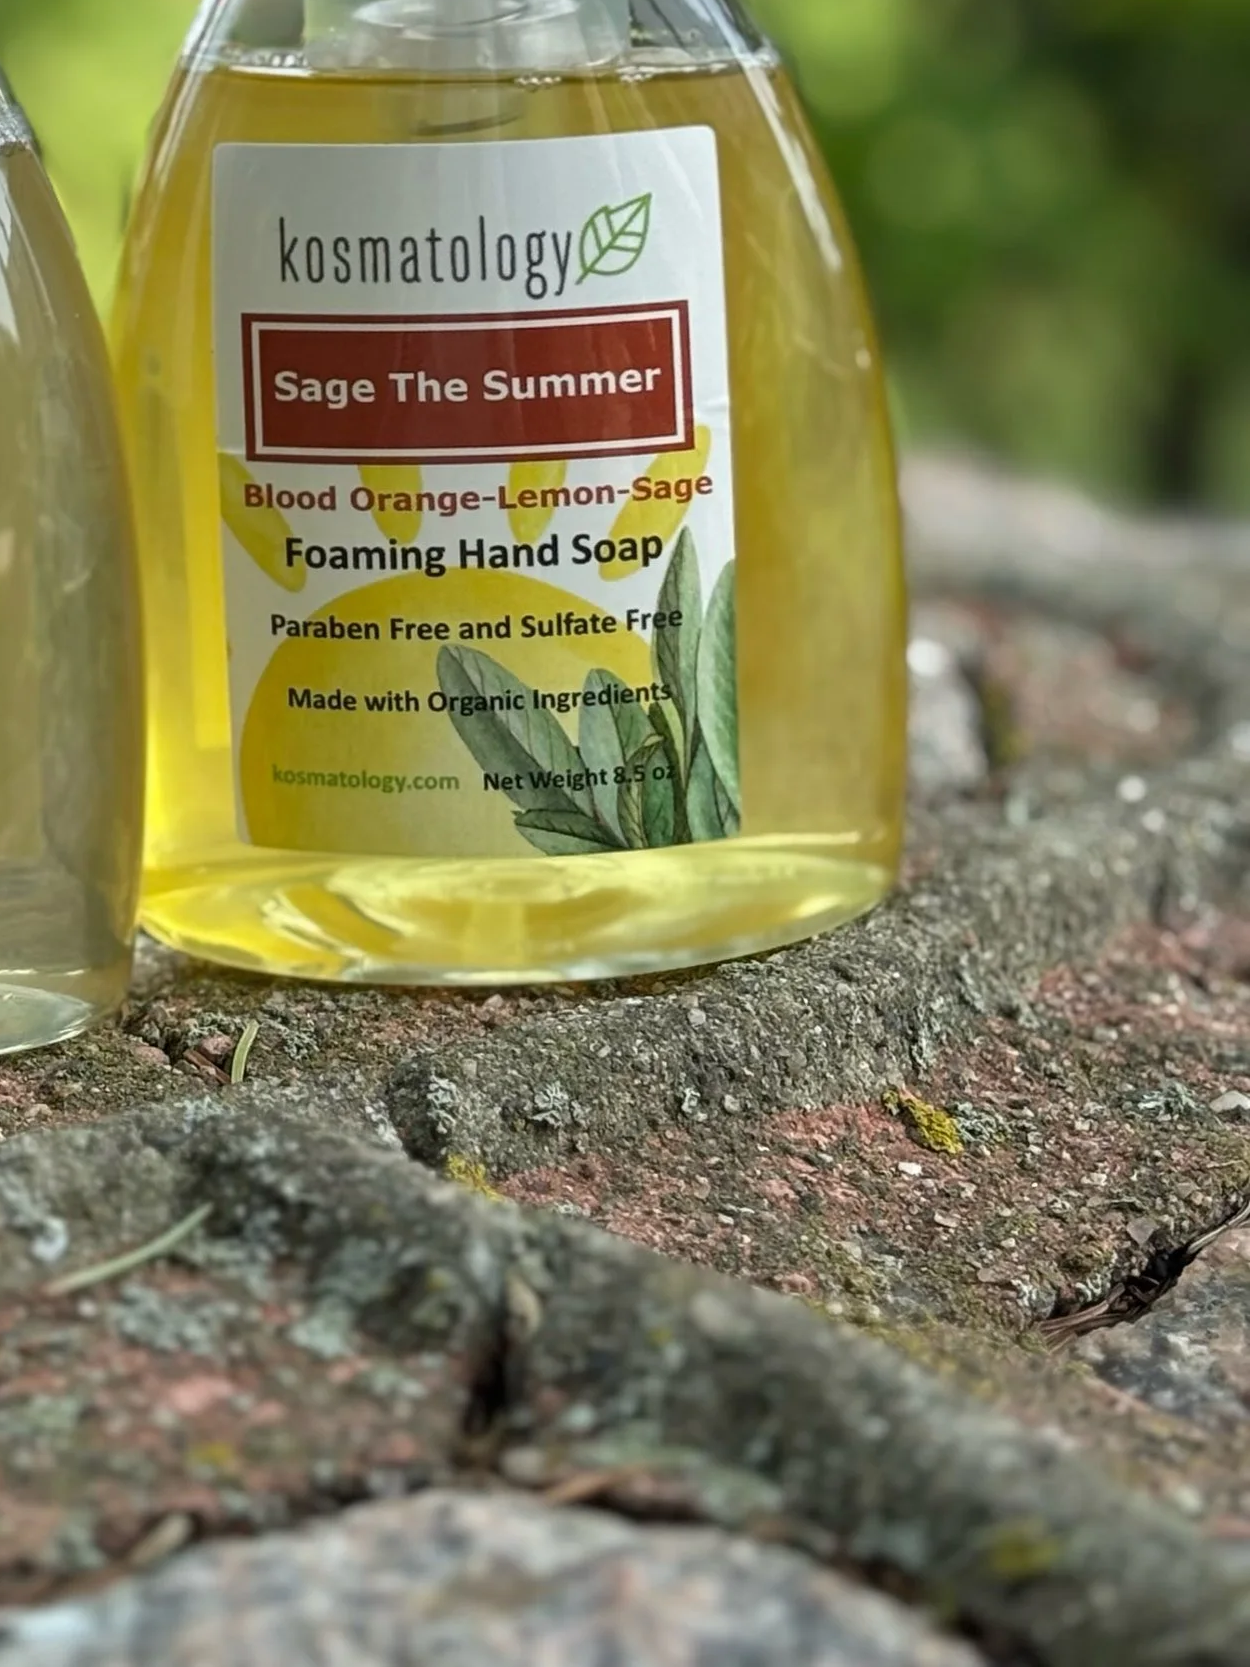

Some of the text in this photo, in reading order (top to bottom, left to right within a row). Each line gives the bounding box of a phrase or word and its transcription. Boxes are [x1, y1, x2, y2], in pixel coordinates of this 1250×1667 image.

[278, 215, 572, 300] kosmatology
[273, 364, 662, 410] Sage The Summer
[243, 483, 337, 512] Blood
[285, 532, 664, 578] Foaming Hand Soap
[270, 607, 684, 641] Paraben Free and Sulfate Free
[287, 680, 672, 718] Made with Organic Ingredients
[271, 763, 461, 794] kosmatology.com
[482, 771, 524, 792] Net
[528, 767, 608, 794] Weight
[612, 764, 646, 785] 8.5
